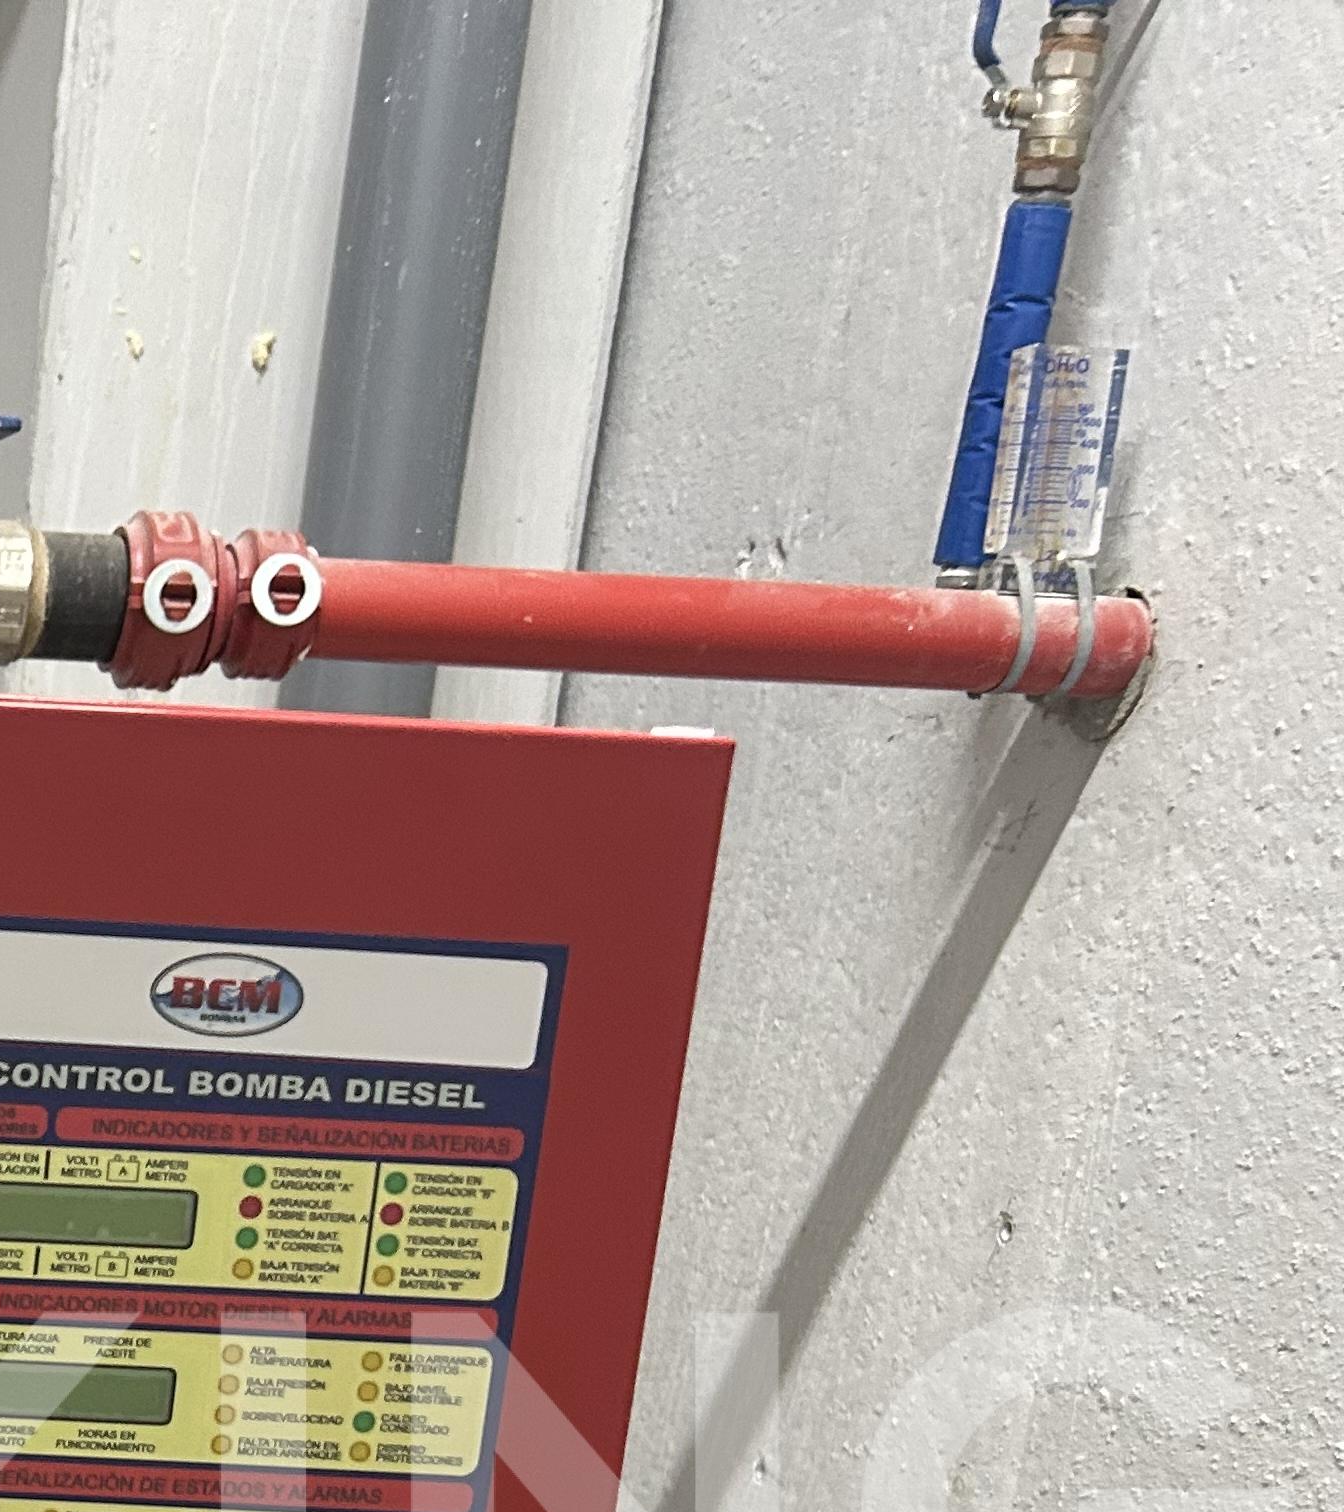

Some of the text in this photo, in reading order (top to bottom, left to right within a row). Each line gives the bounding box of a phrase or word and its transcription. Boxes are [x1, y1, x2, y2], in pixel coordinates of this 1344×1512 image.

[171, 976, 283, 1013] BCM
[188, 1069, 333, 1103] BOMBA
[346, 1078, 487, 1110] DIESEL
[92, 1117, 233, 1144] INDICADORES
[240, 1123, 252, 1136] Y
[258, 1124, 404, 1149] SEÑALIZACIÓN
[67, 1155, 98, 1166] VOLTI
[145, 1159, 188, 1170] AMPERI
[61, 1168, 101, 1178] METRO
[145, 1172, 186, 1182] METRO
[325, 1169, 341, 1179] EN
[56, 1251, 88, 1262] VOLTI
[134, 1254, 177, 1266] AMPERI
[50, 1263, 91, 1274] METRO
[134, 1266, 174, 1278] METRO
[0, 1292, 140, 1313] INDICADORES
[143, 1298, 217, 1319] MOTOR
[316, 1308, 411, 1328] ALARMAS
[78, 1428, 136, 1440] HORAS EN
[140, 1478, 167, 1493] DE
[172, 1478, 263, 1498] ESTADOS
[272, 1482, 286, 1496] Y
[289, 1482, 382, 1504] ALARMAS
